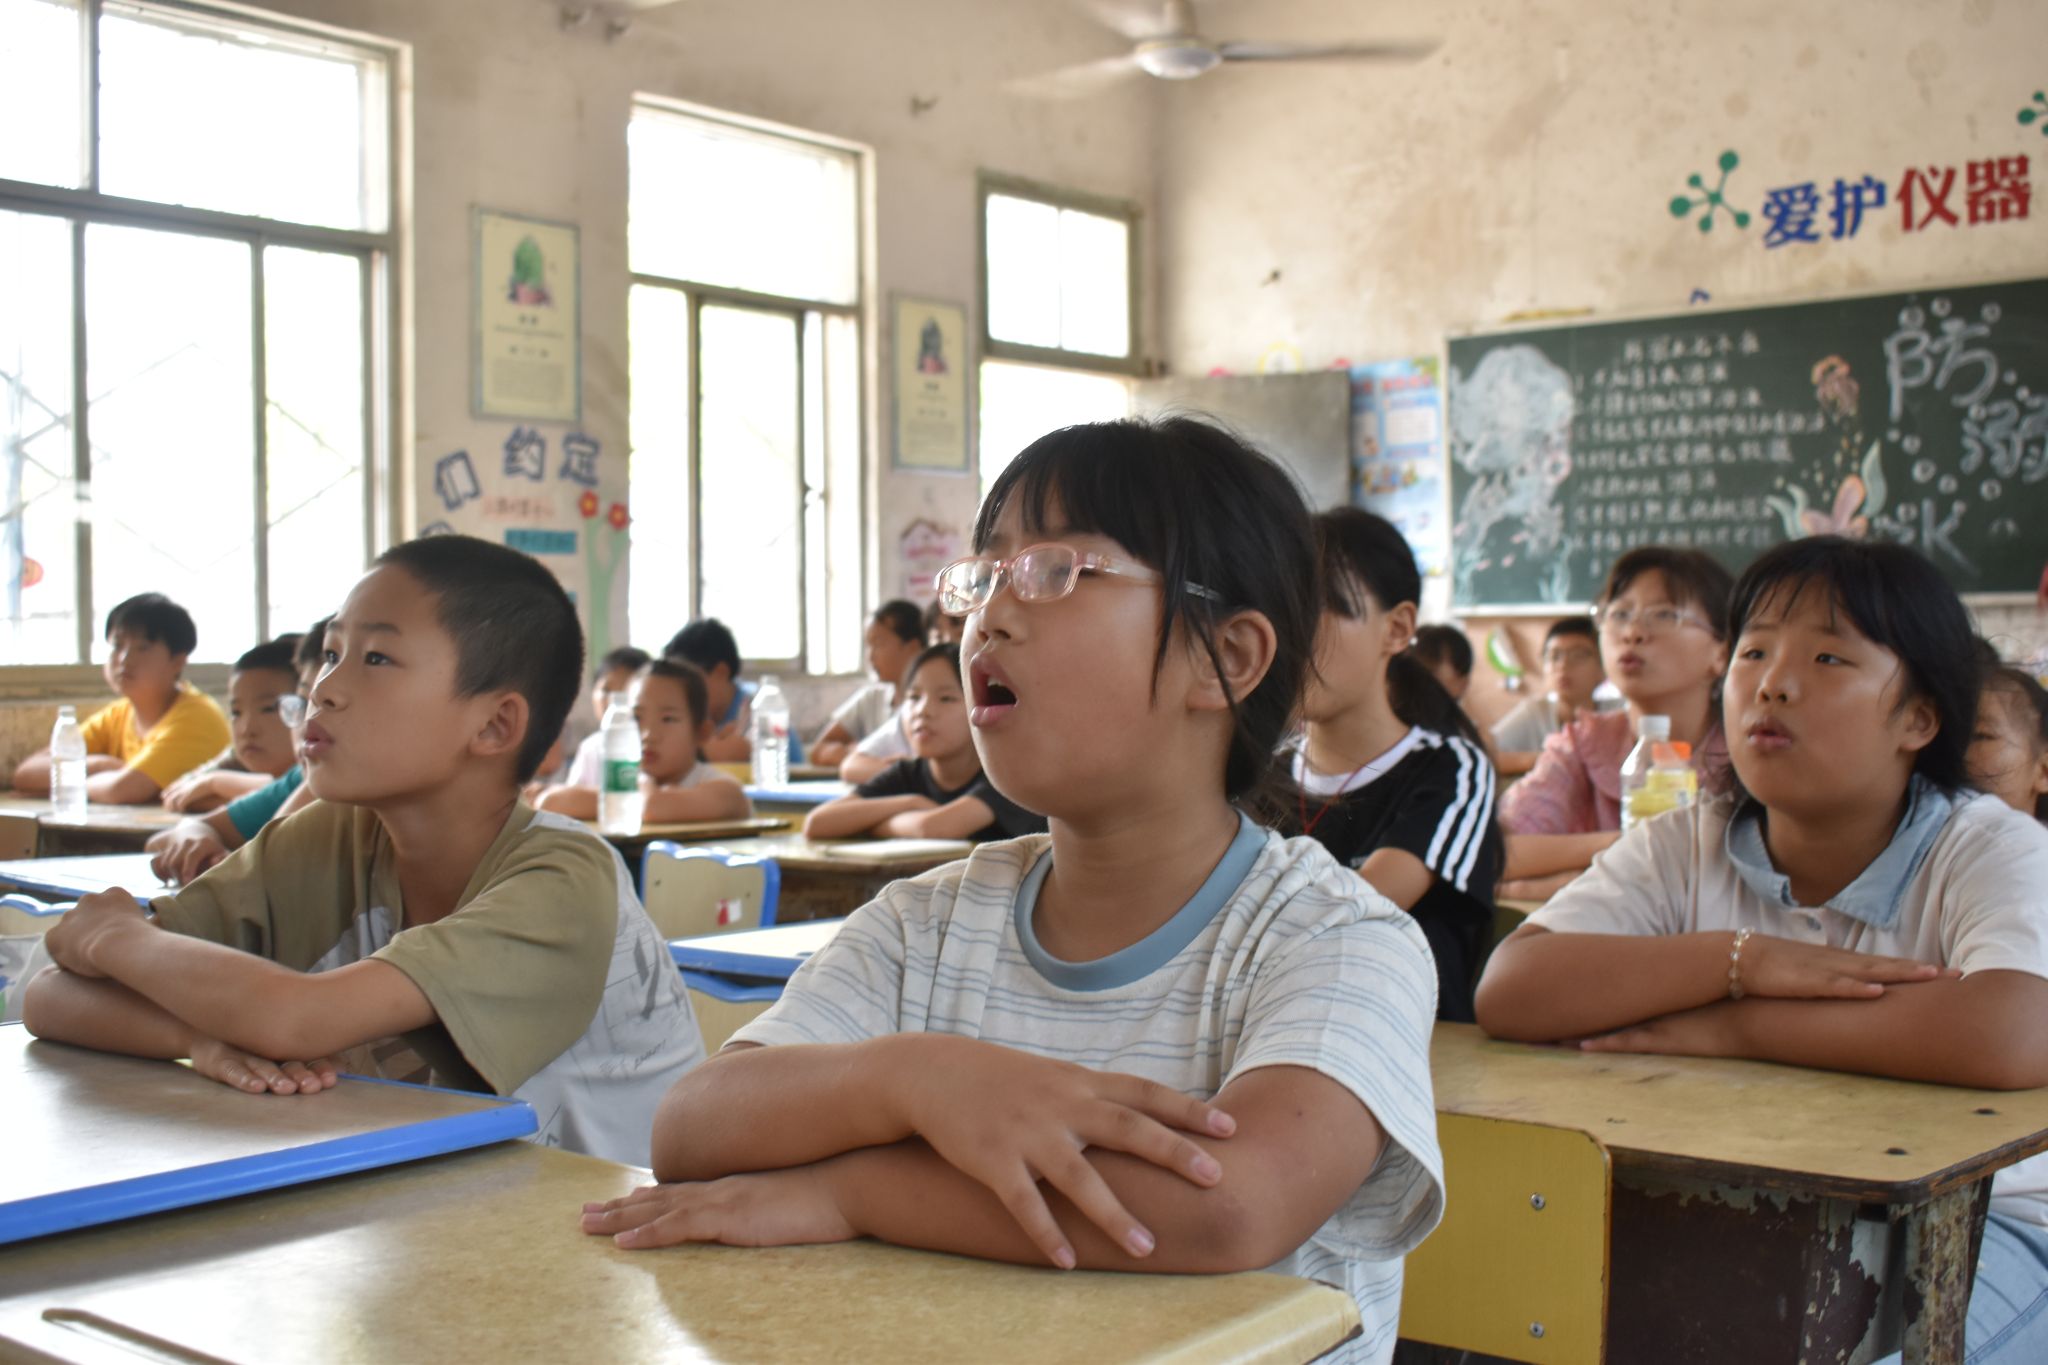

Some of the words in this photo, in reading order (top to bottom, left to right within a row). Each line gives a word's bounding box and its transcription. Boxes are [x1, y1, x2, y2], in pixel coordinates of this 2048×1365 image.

[1762, 154, 2031, 249] 爱护仪器
[1883, 317, 1998, 422] 防
